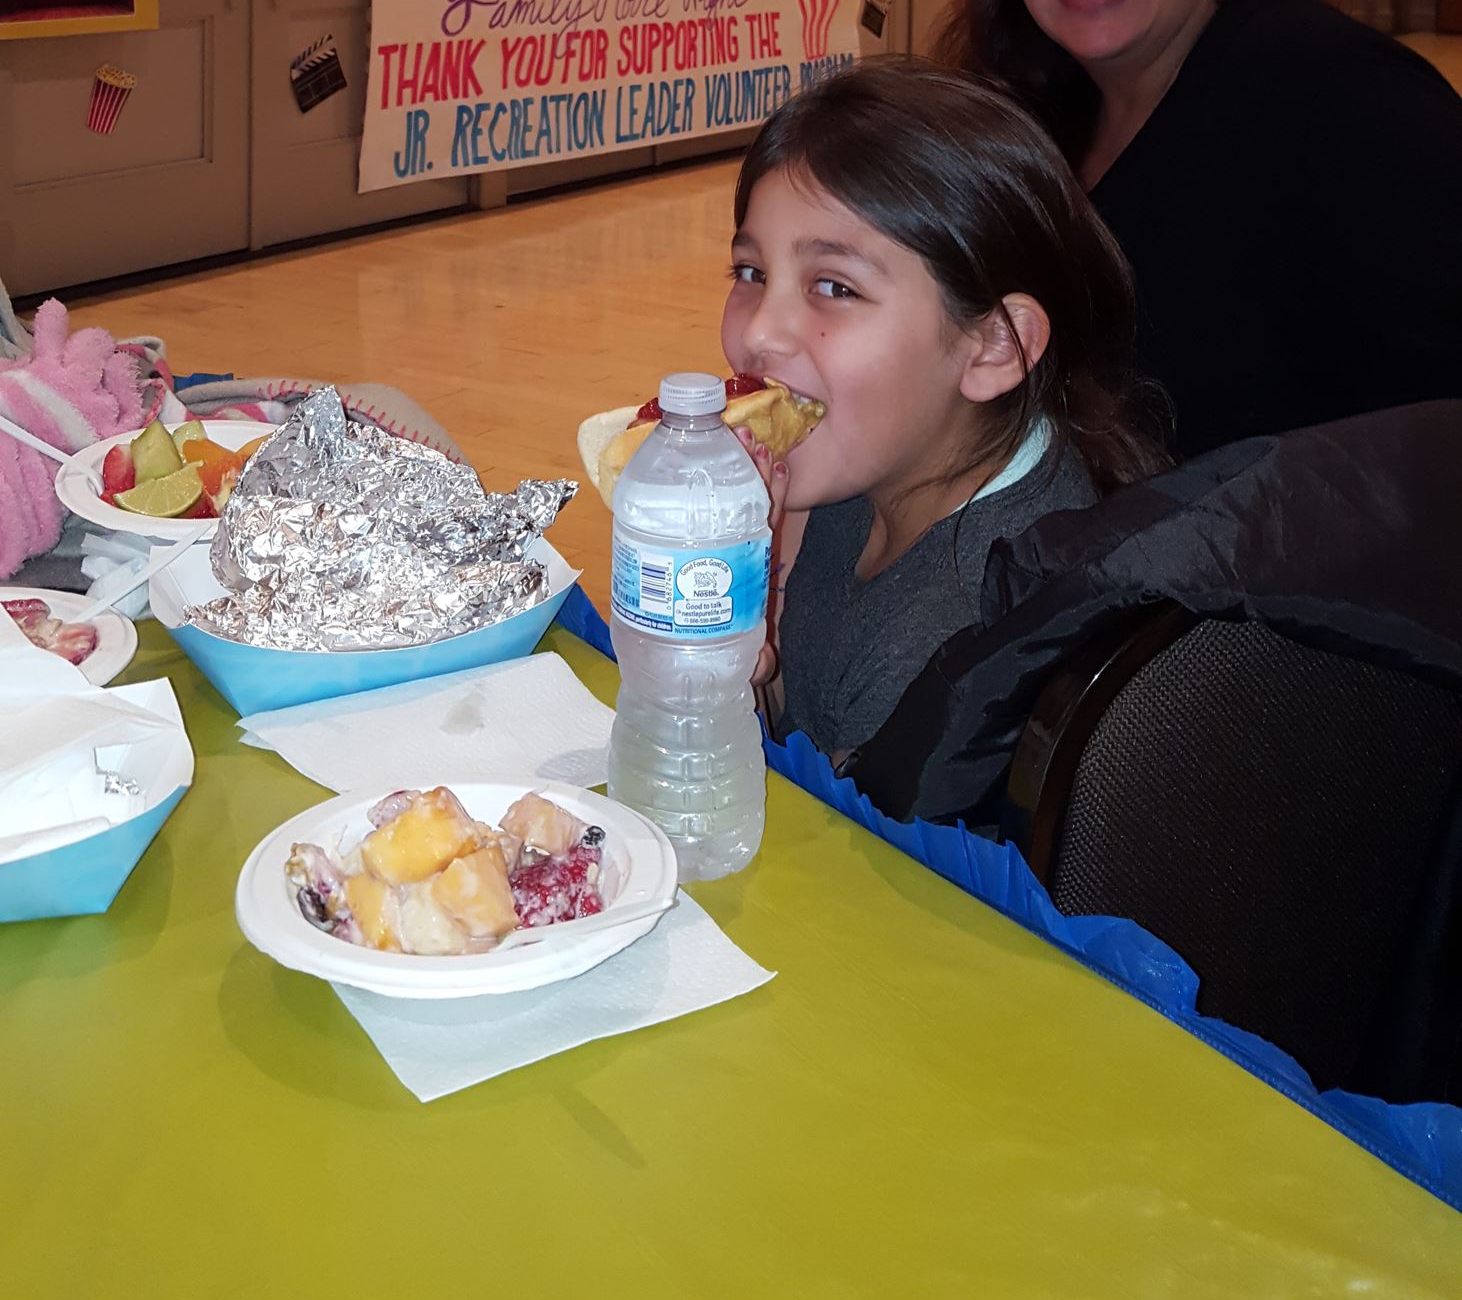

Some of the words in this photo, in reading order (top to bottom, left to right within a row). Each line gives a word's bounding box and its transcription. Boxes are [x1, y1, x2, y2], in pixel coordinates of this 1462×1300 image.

[377, 38, 487, 110] THANK
[501, 33, 559, 90] YOU
[560, 28, 609, 85] FOR
[616, 14, 739, 77] SUPPORTING
[744, 11, 782, 61] THE
[394, 109, 433, 178] JR.
[451, 88, 607, 167] RECREATION
[615, 77, 696, 144] LEADER
[704, 65, 791, 129] VOLUNTEER
[708, 558, 722, 568] Good
[685, 602, 703, 610] Good
[710, 601, 722, 609] talk
[674, 627, 707, 635] NUTRITIONAL
